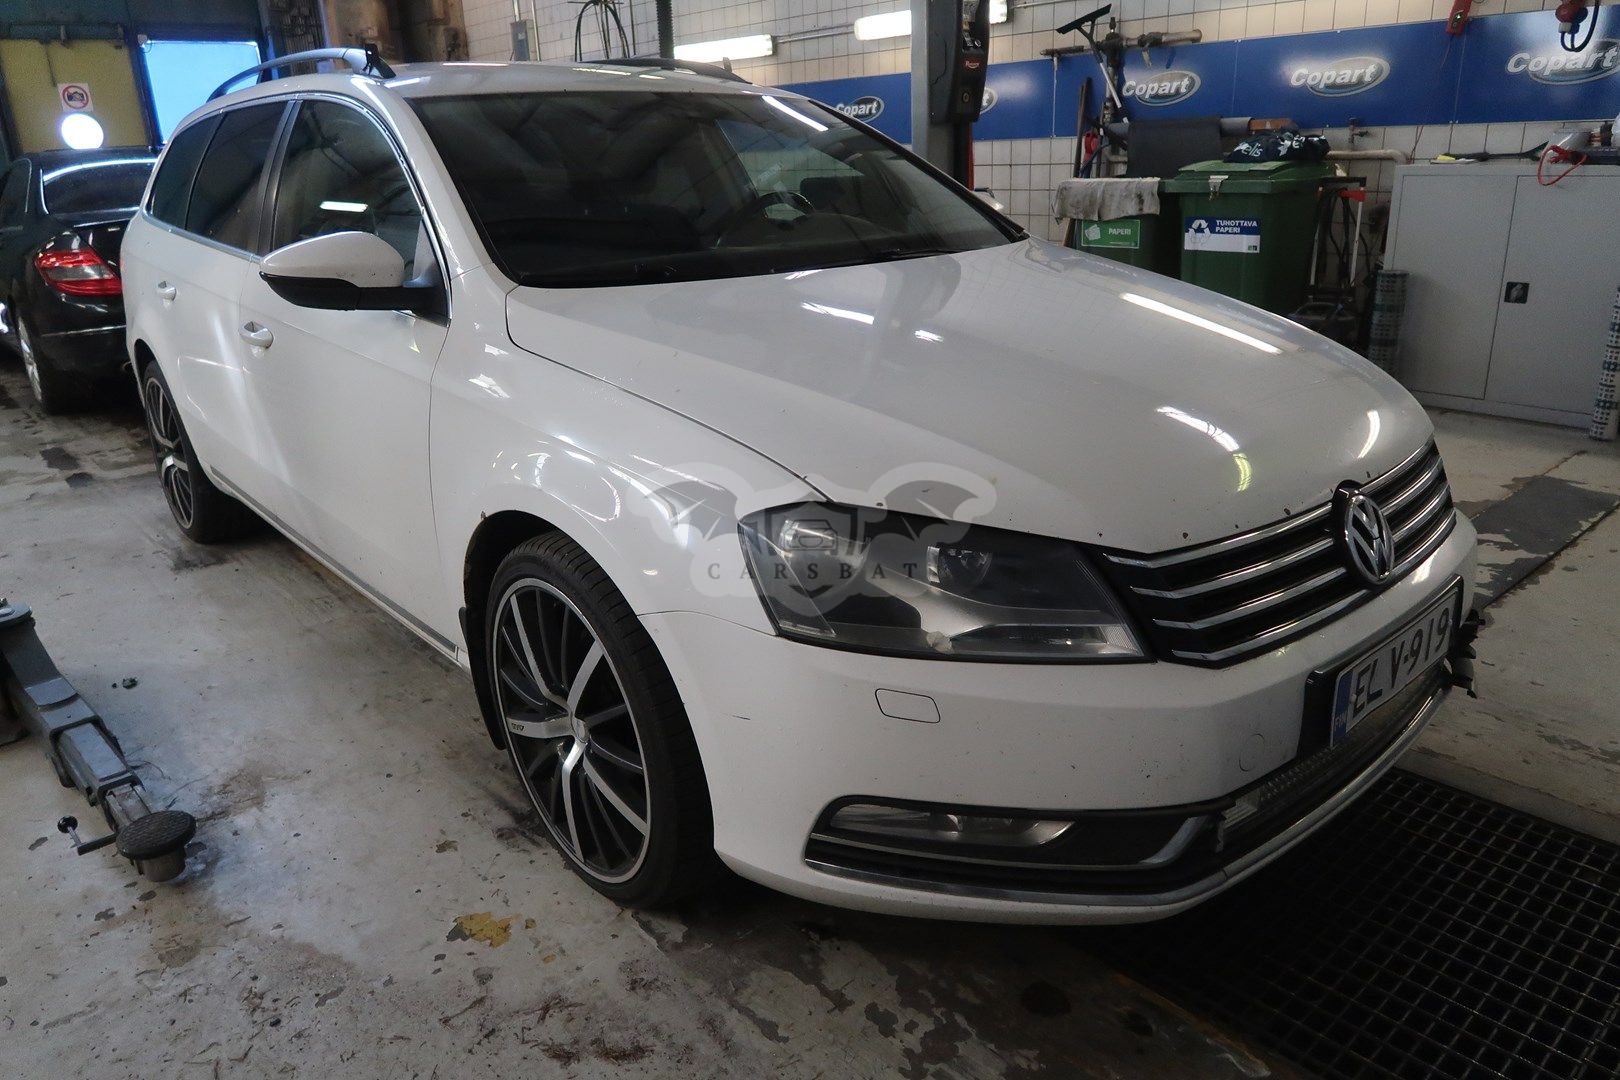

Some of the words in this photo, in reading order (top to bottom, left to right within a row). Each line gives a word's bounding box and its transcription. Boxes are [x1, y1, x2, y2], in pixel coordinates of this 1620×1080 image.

[1507, 47, 1618, 76] Copart
[1122, 76, 1190, 99] Copart
[1290, 64, 1377, 89] Copart
[1215, 219, 1258, 227] TUHOTTAVA
[1352, 607, 1450, 718] ELV-919
